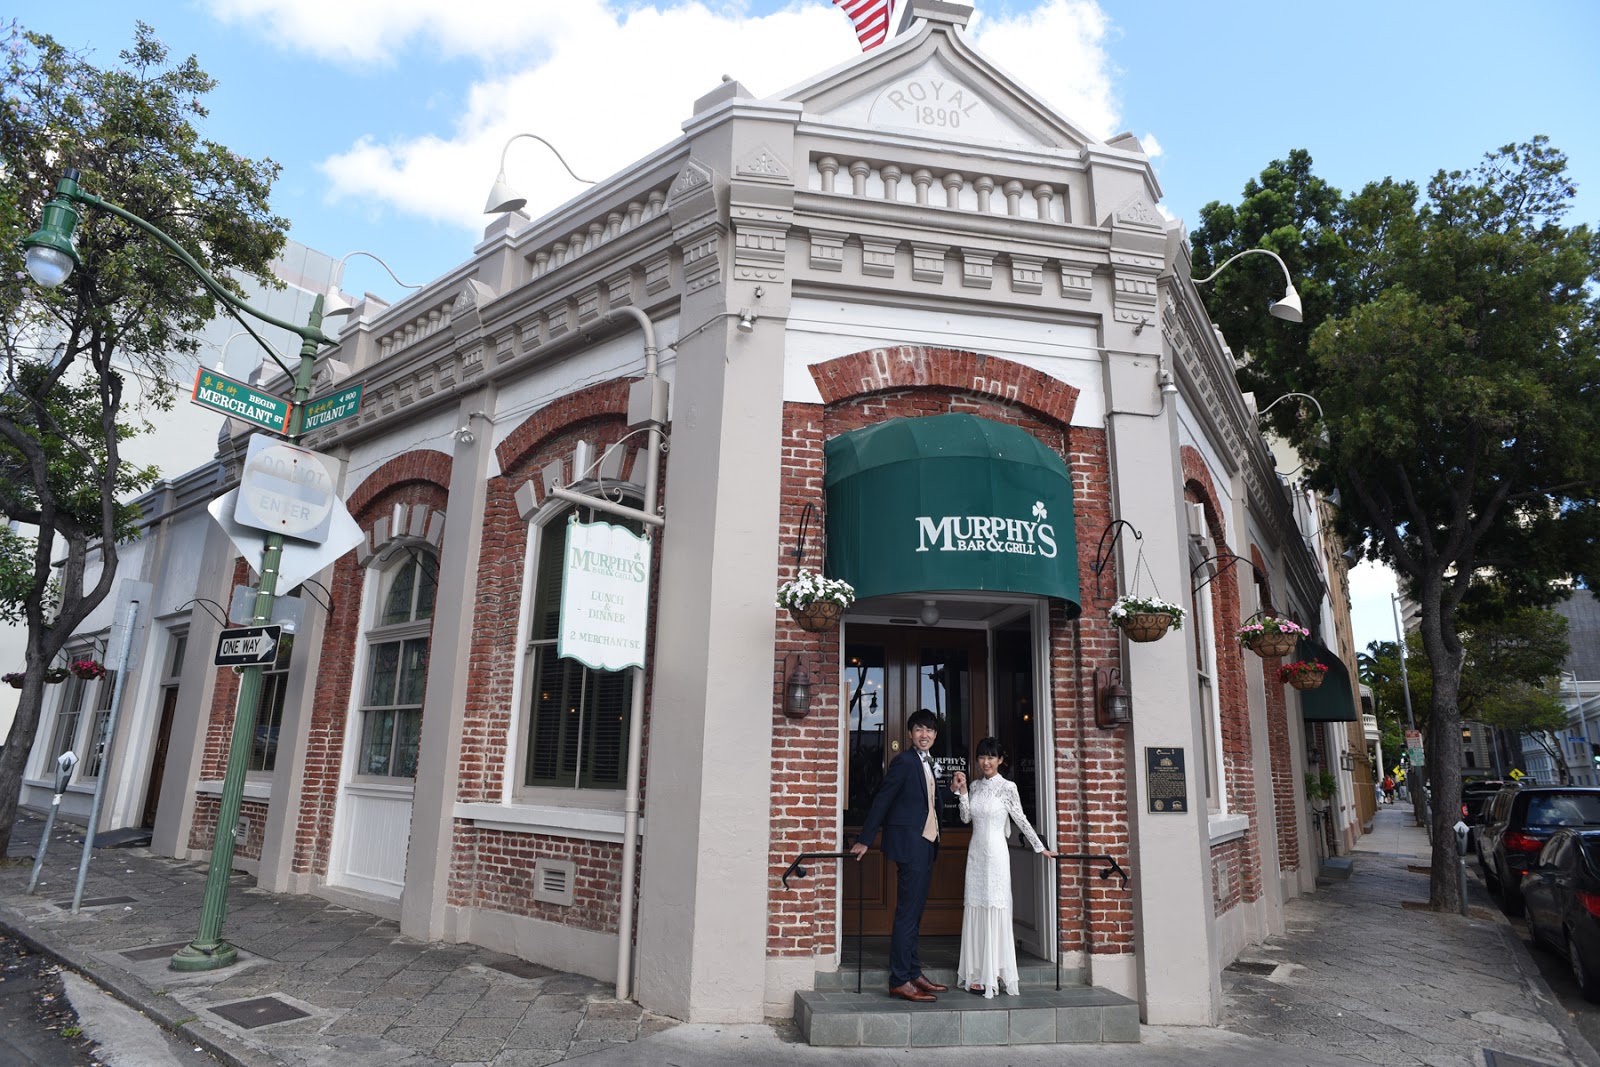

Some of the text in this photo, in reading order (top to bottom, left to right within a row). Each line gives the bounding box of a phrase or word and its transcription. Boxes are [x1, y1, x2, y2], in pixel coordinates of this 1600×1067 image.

[887, 81, 978, 118] ROYAL
[916, 105, 960, 128] 1890
[249, 394, 277, 410] BEGIN
[345, 391, 357, 401] 900
[198, 386, 284, 424] MERCHANT ST
[263, 455, 285, 474] DO
[260, 495, 311, 520] ENTER
[591, 590, 625, 606] LUNCH
[603, 602, 611, 612] &
[588, 609, 626, 624] DINNER
[223, 638, 261, 655] ONE WAY
[569, 631, 577, 640] 2
[579, 632, 629, 648] MERCHANT
[931, 757, 967, 766] URPHY'S
